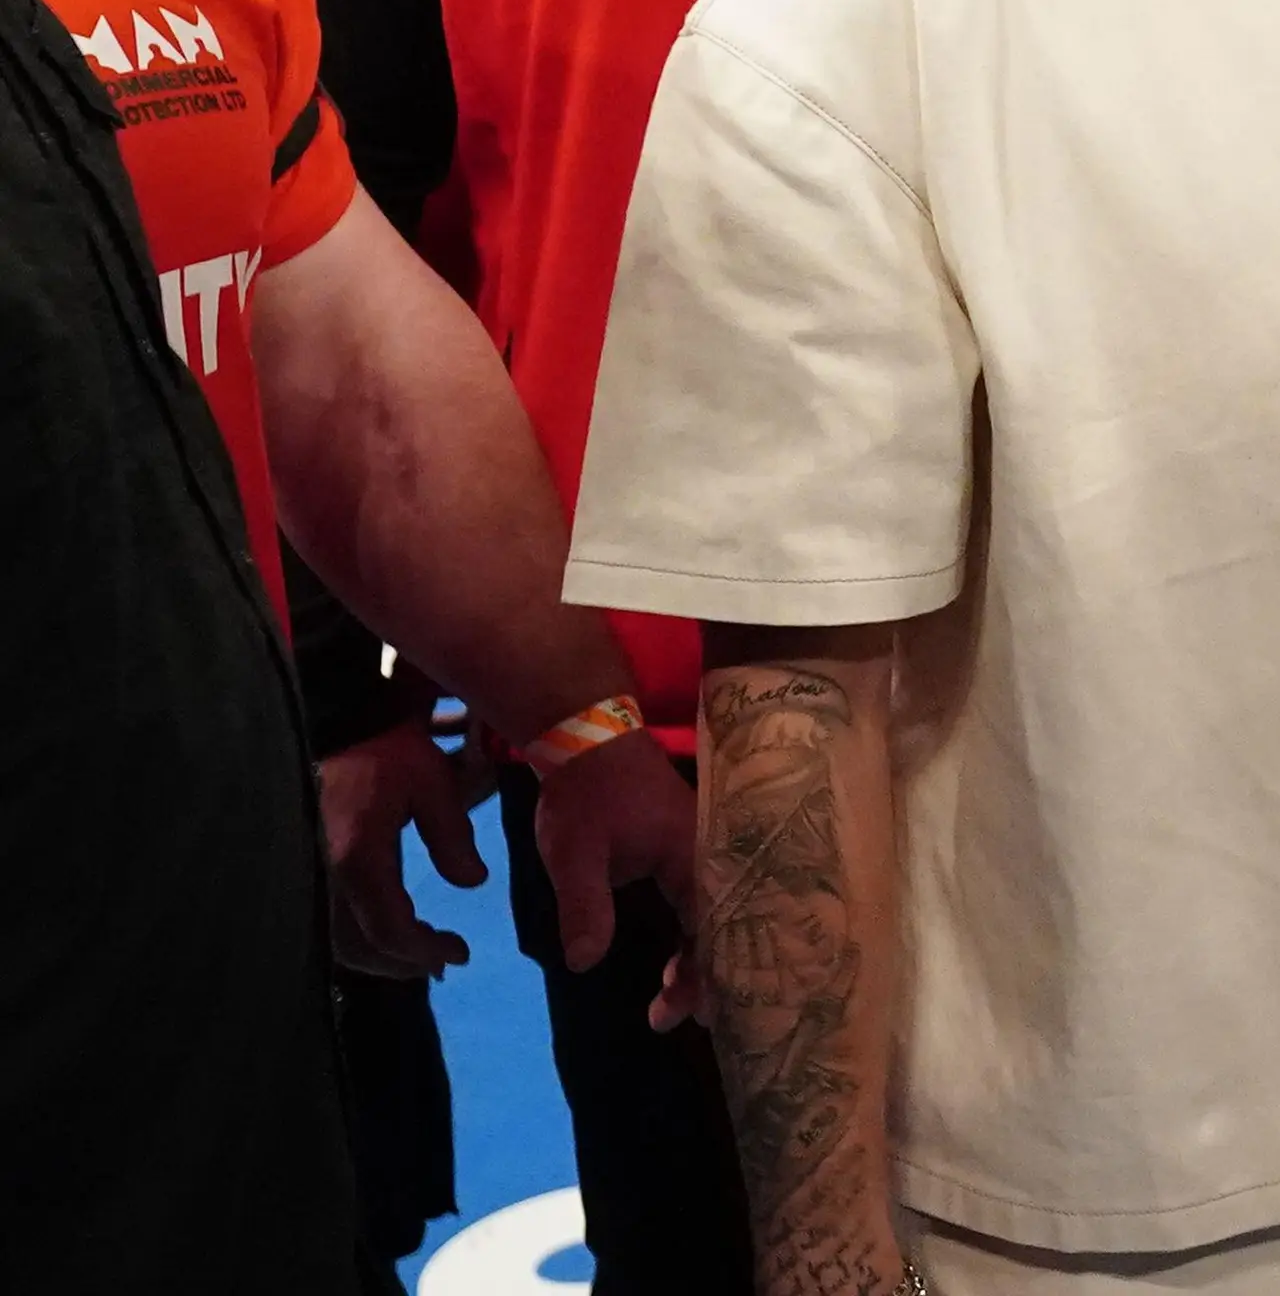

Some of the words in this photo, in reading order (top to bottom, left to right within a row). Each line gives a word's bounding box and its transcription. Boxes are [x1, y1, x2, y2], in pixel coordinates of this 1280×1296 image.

[106, 65, 237, 99] OMMERCIAL
[125, 93, 216, 125] OTECTION
[222, 90, 246, 110] LTD
